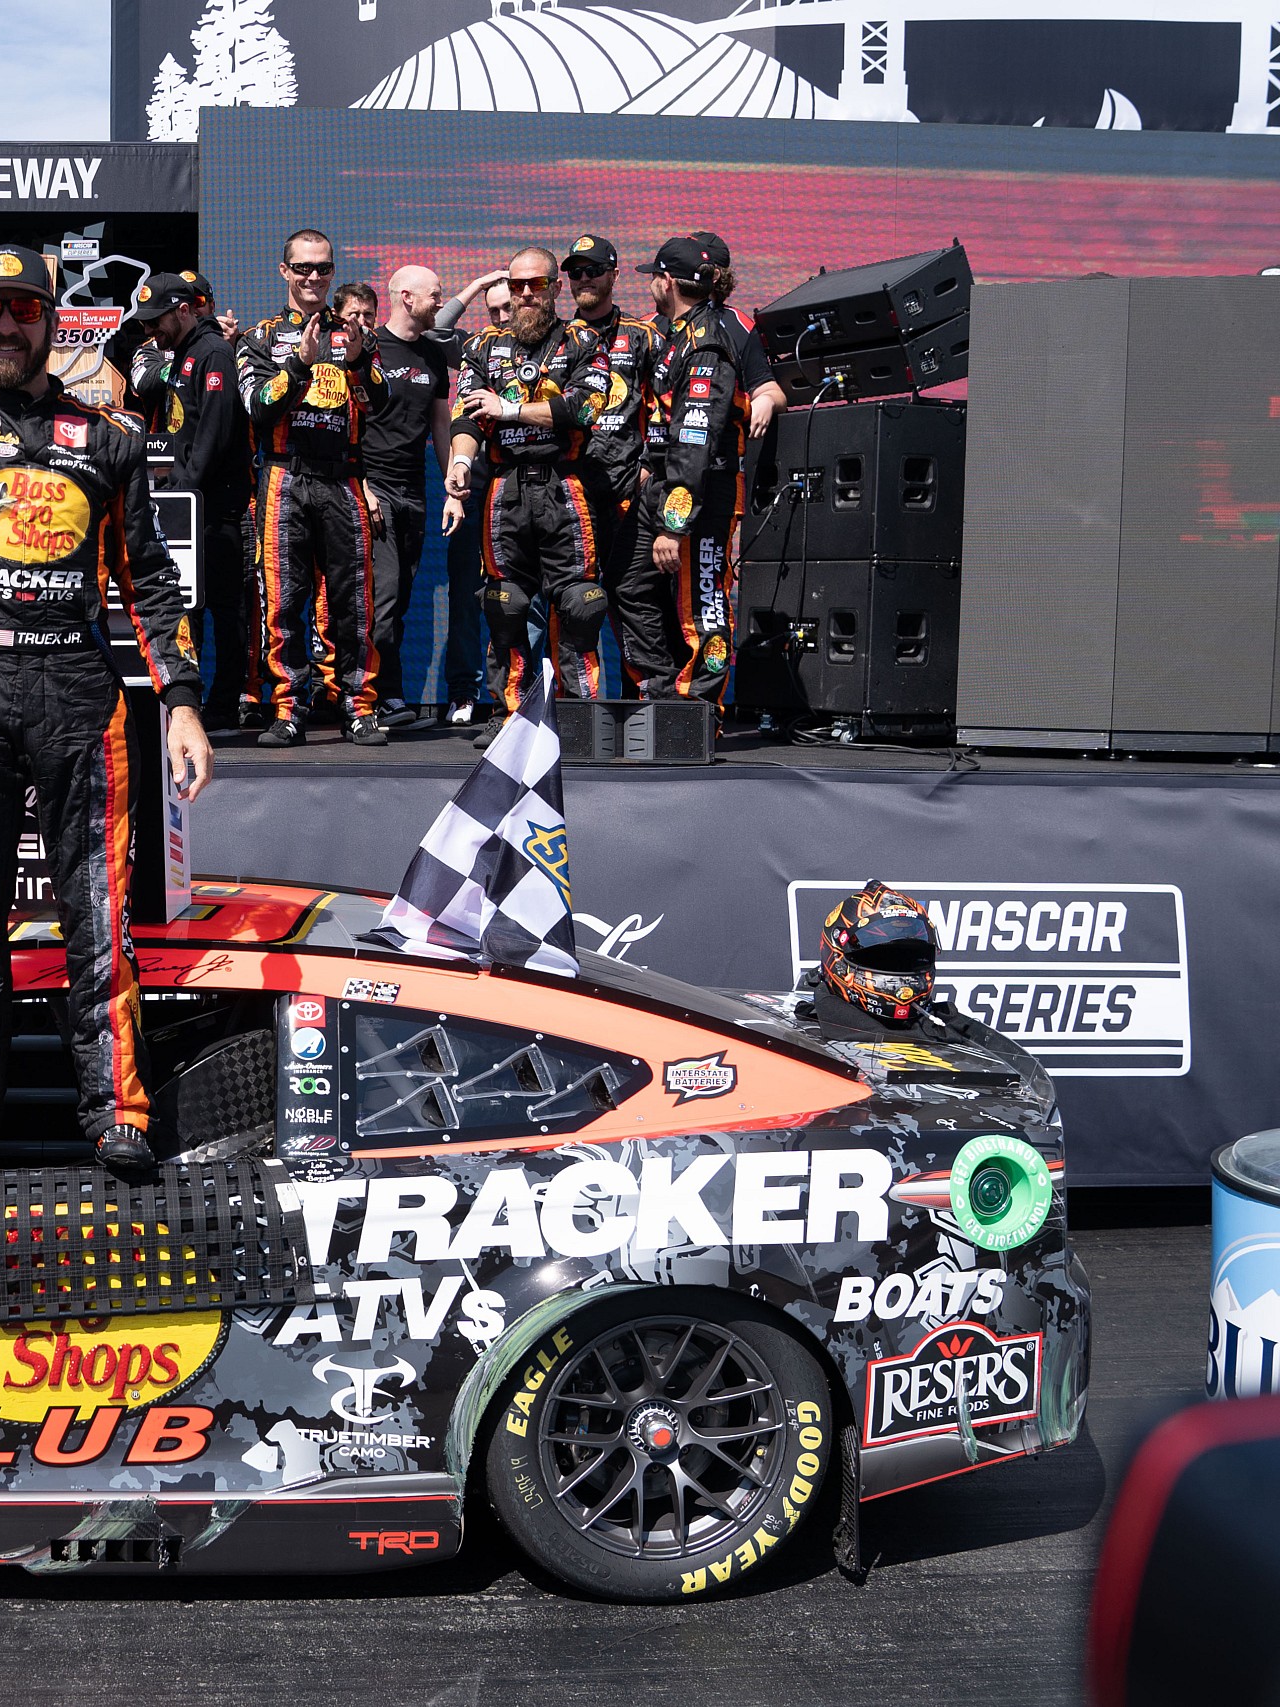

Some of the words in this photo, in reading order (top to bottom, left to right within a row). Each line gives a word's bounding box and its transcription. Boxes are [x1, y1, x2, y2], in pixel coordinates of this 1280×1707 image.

[57, 328, 95, 343] 350
[316, 365, 341, 378] Bass
[700, 367, 714, 376] 75
[317, 378, 335, 389] Pro
[317, 388, 347, 404] Shops
[290, 411, 346, 426] TRACKER
[499, 425, 552, 439] TRACKE
[147, 440, 168, 452] nity
[49, 458, 97, 475] GOODYEAR
[9, 471, 67, 501] Bass
[8, 498, 53, 524] Pro
[6, 519, 76, 558] Shops
[699, 536, 718, 632] TRACKER
[37, 589, 74, 601] ATVs
[714, 590, 726, 626] BOATS
[17, 632, 62, 646] TRUEX
[64, 632, 83, 644] JR.
[924, 900, 1128, 953] NASCAR
[967, 984, 1137, 1033] SERIES
[284, 1061, 333, 1071] Auto-Owners
[671, 1069, 729, 1077] INTERSTATE
[285, 1107, 333, 1120] NOBLE
[979, 1111, 1017, 1131] VIPER
[952, 1159, 970, 1186] GET
[968, 1138, 1039, 1169] BIOETHANOL
[282, 1148, 892, 1266] TRACKER
[986, 1197, 1048, 1248] BIOETHANOL
[833, 1268, 1008, 1322] BOATS
[272, 1275, 507, 1345] ATVs
[2, 1328, 180, 1400] Shops
[506, 1326, 574, 1438] EAGLE
[878, 1345, 1029, 1434] RESER'S
[916, 1406, 944, 1422] FINE
[297, 1428, 431, 1449] TRUETIMBER
[339, 1446, 386, 1459] CAMO
[681, 1400, 823, 1595] GOODYEAR
[348, 1530, 440, 1555] TRD
